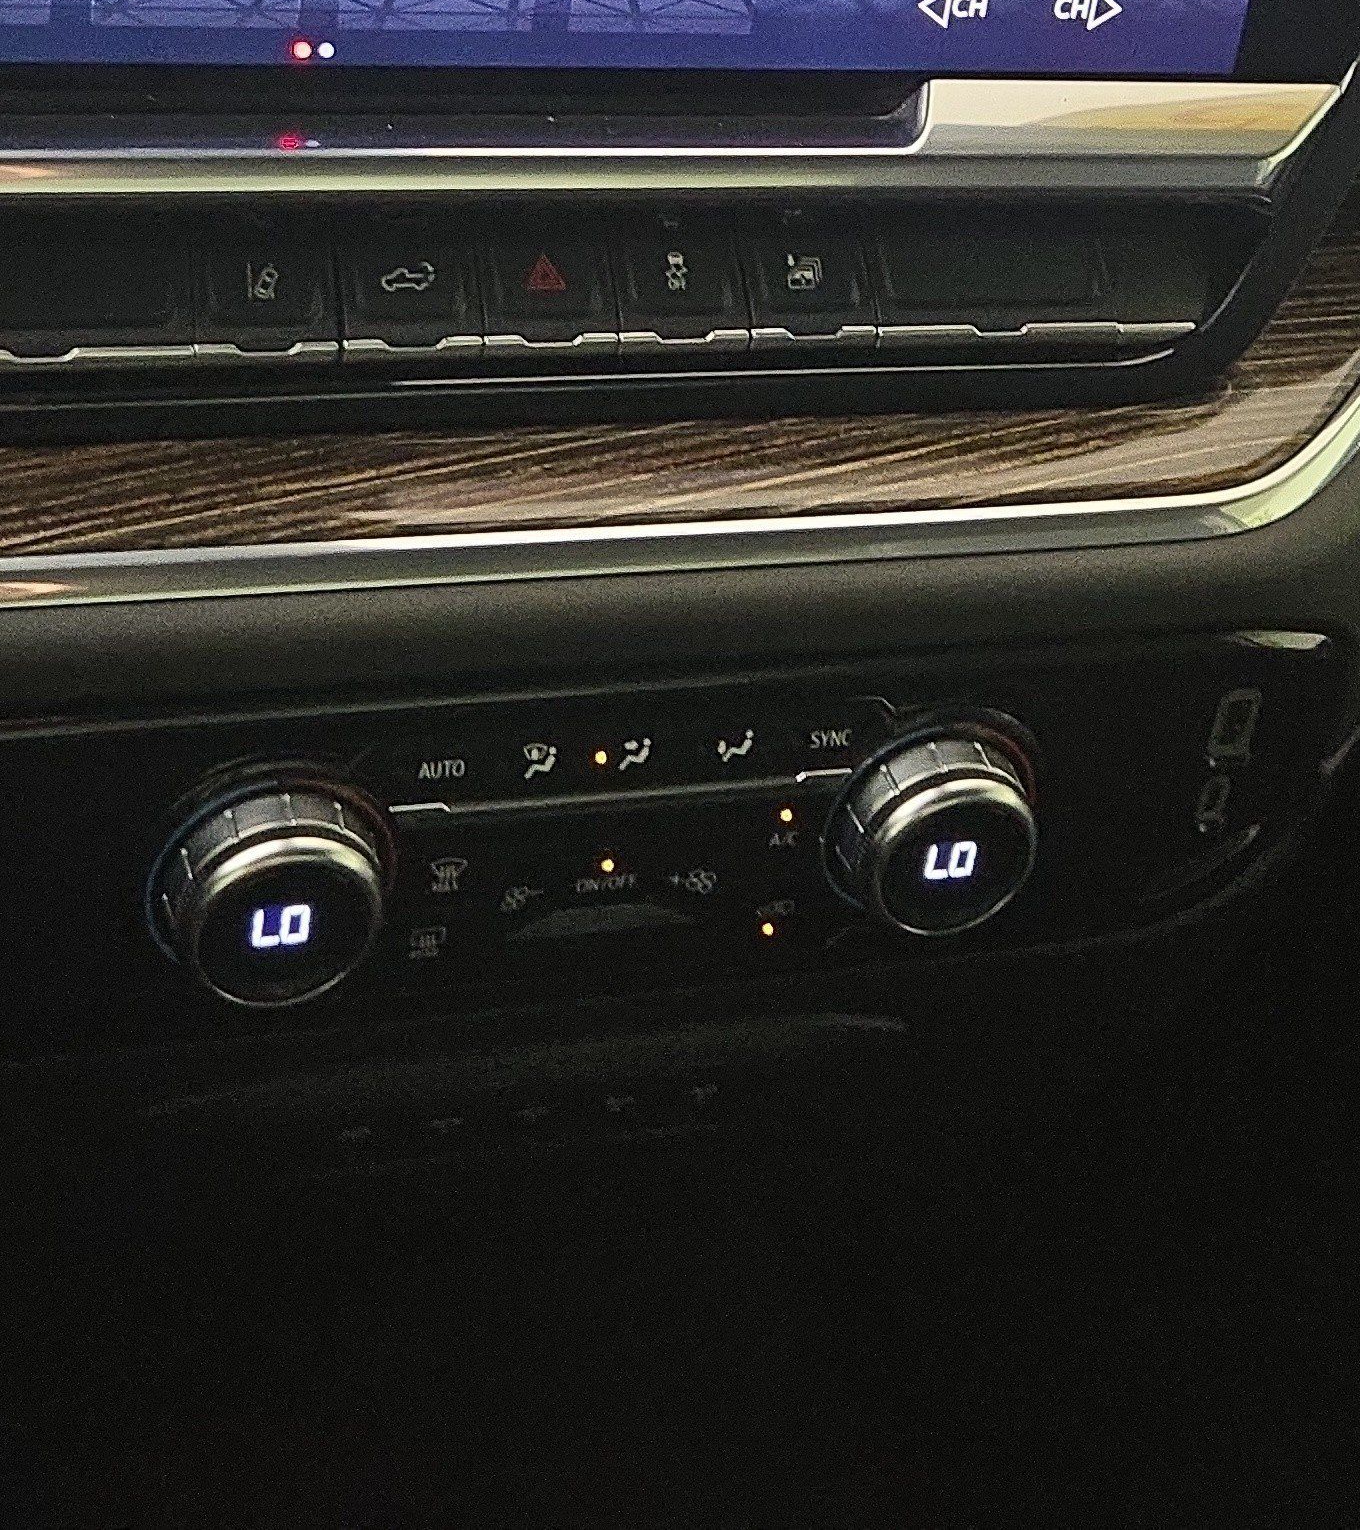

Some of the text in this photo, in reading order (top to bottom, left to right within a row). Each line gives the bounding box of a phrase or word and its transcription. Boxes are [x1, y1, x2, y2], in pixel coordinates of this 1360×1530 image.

[810, 729, 850, 749] SYNC
[418, 759, 466, 779] AUTO
[923, 840, 978, 880] LO
[251, 904, 312, 948] LO
